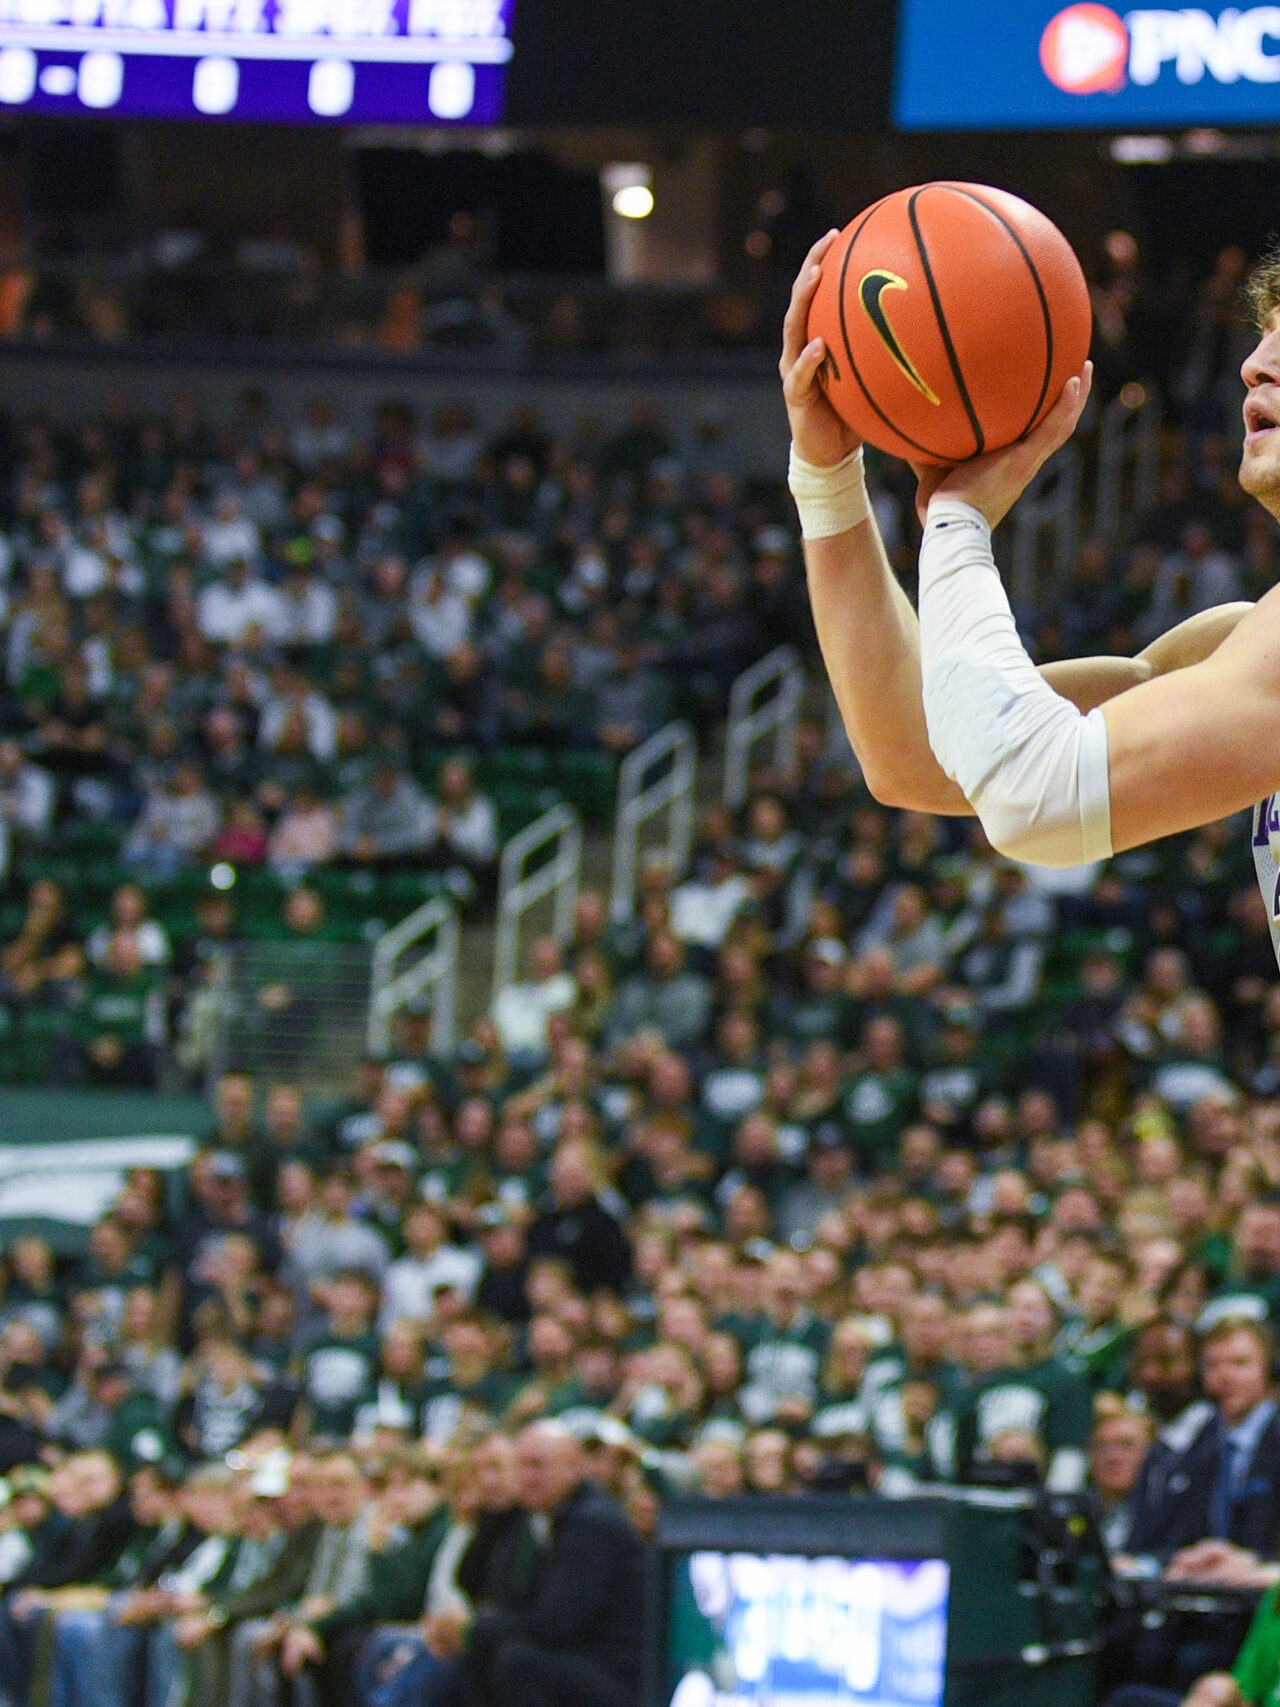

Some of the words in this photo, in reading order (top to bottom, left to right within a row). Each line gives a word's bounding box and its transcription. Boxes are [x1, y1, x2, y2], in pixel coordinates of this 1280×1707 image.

[192, 56, 240, 115] 0
[308, 59, 355, 117] 0
[428, 62, 475, 119] 0
